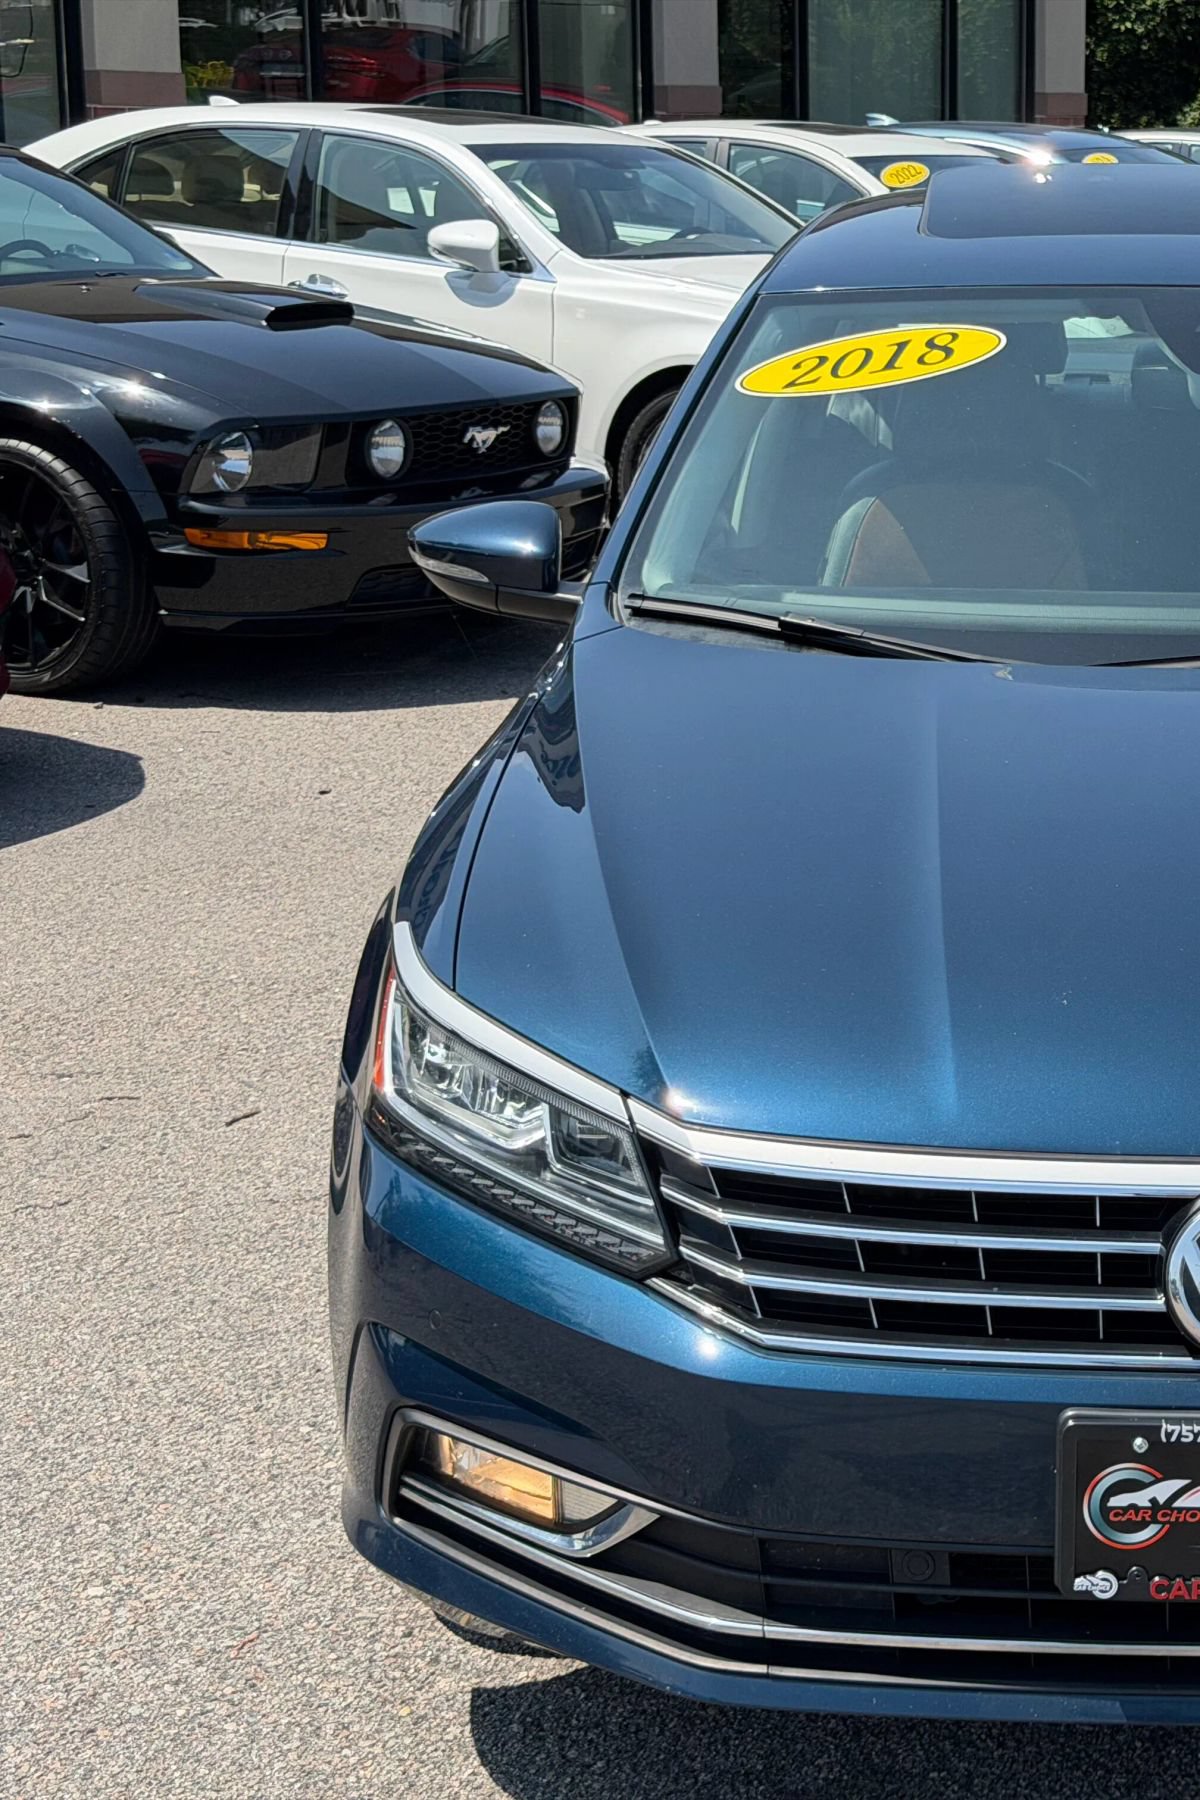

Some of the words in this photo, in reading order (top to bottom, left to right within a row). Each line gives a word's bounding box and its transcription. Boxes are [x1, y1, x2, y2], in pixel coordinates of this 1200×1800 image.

[890, 164, 922, 184] 2022
[782, 331, 959, 390] 2018
[1109, 1509, 1152, 1521] CAR
